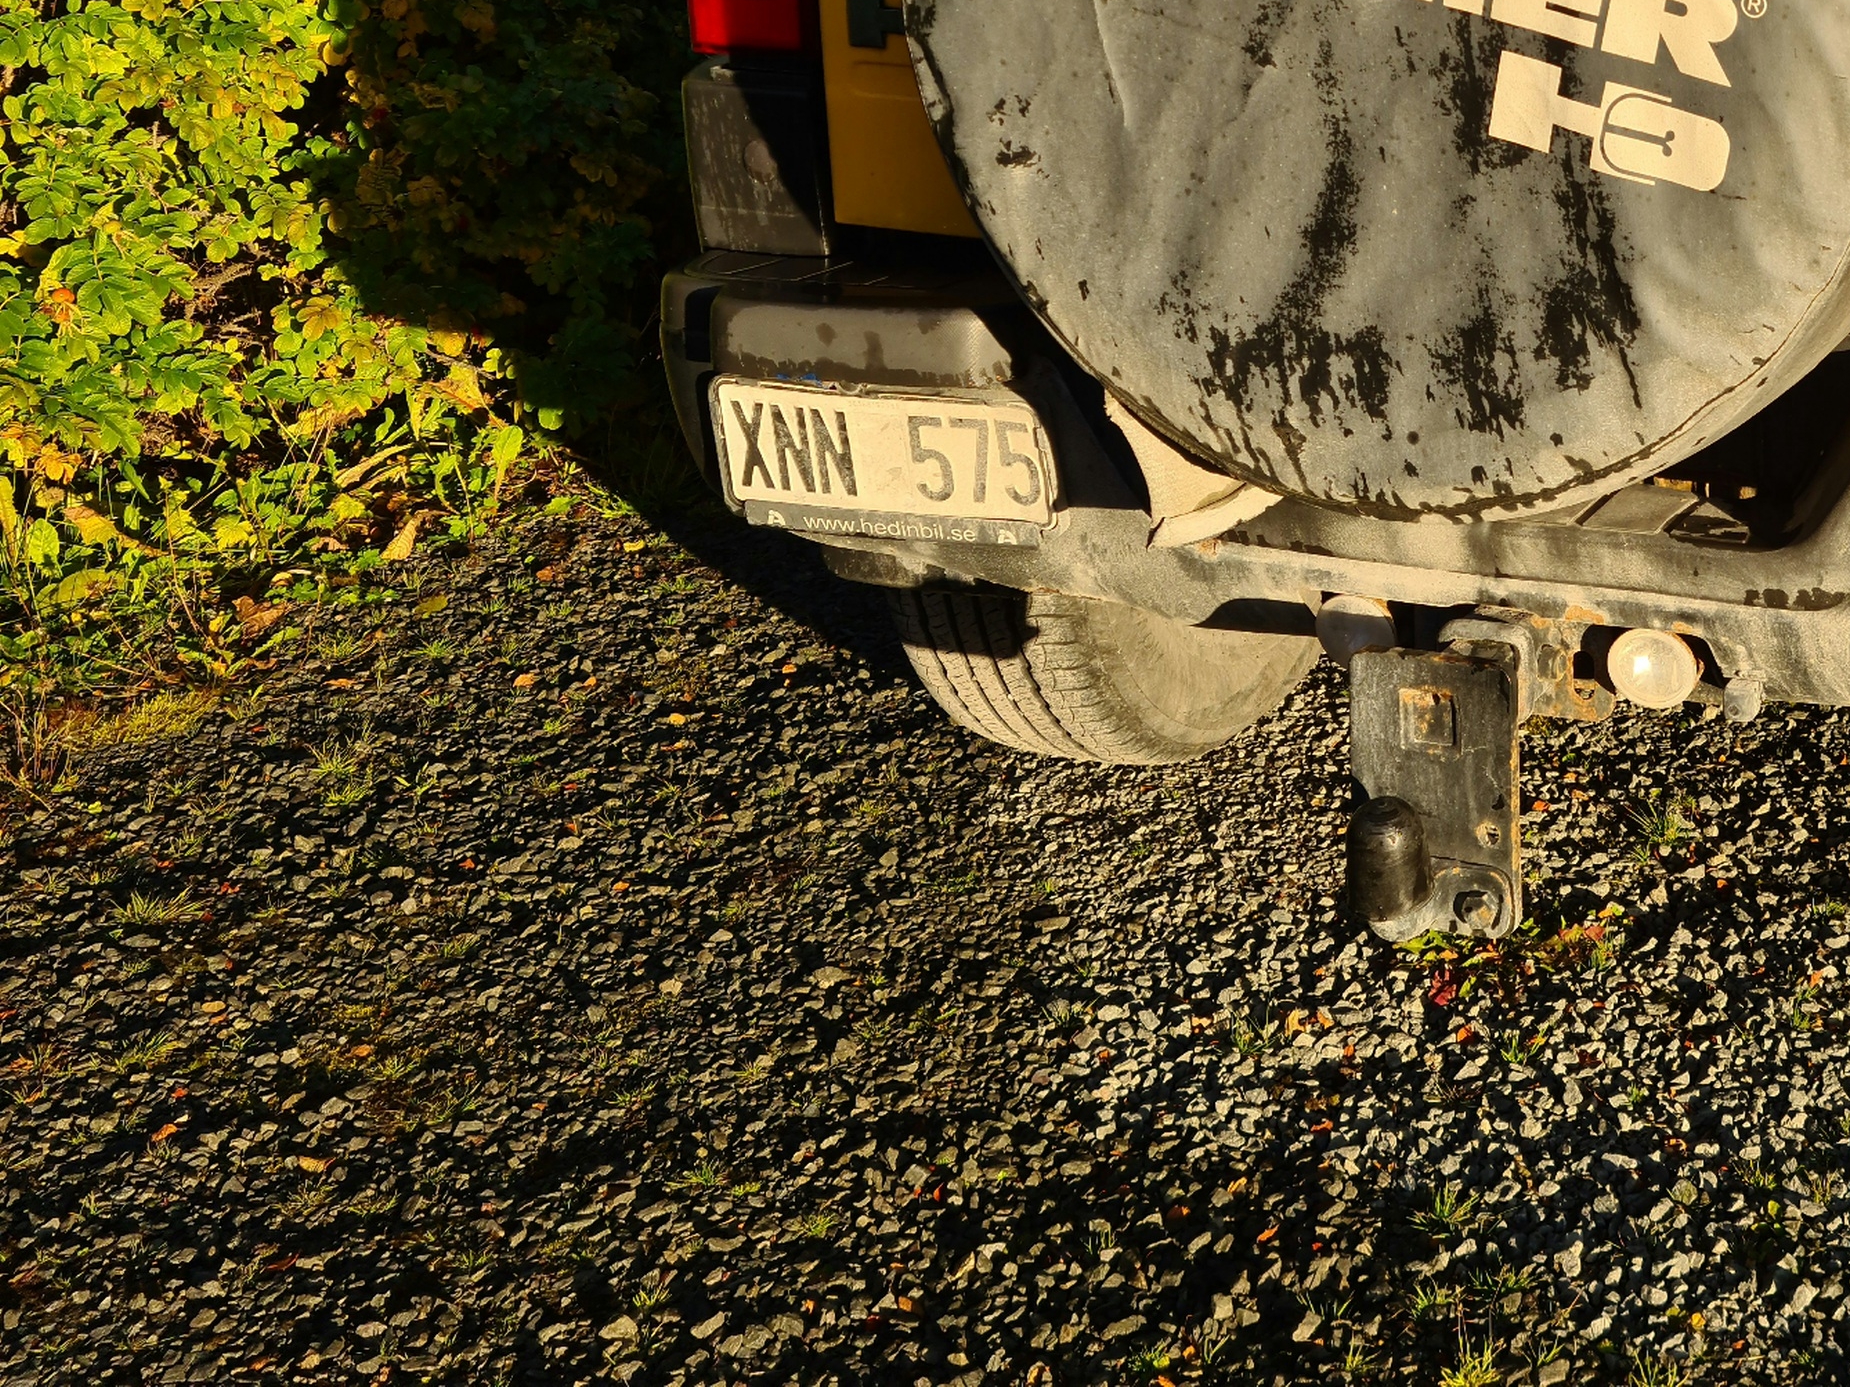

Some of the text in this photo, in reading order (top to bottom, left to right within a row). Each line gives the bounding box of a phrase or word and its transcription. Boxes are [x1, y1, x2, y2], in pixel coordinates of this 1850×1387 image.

[1488, 50, 1731, 193] H3
[730, 400, 1043, 506] XNN 575
[803, 514, 976, 543] www.hedinbil.se
